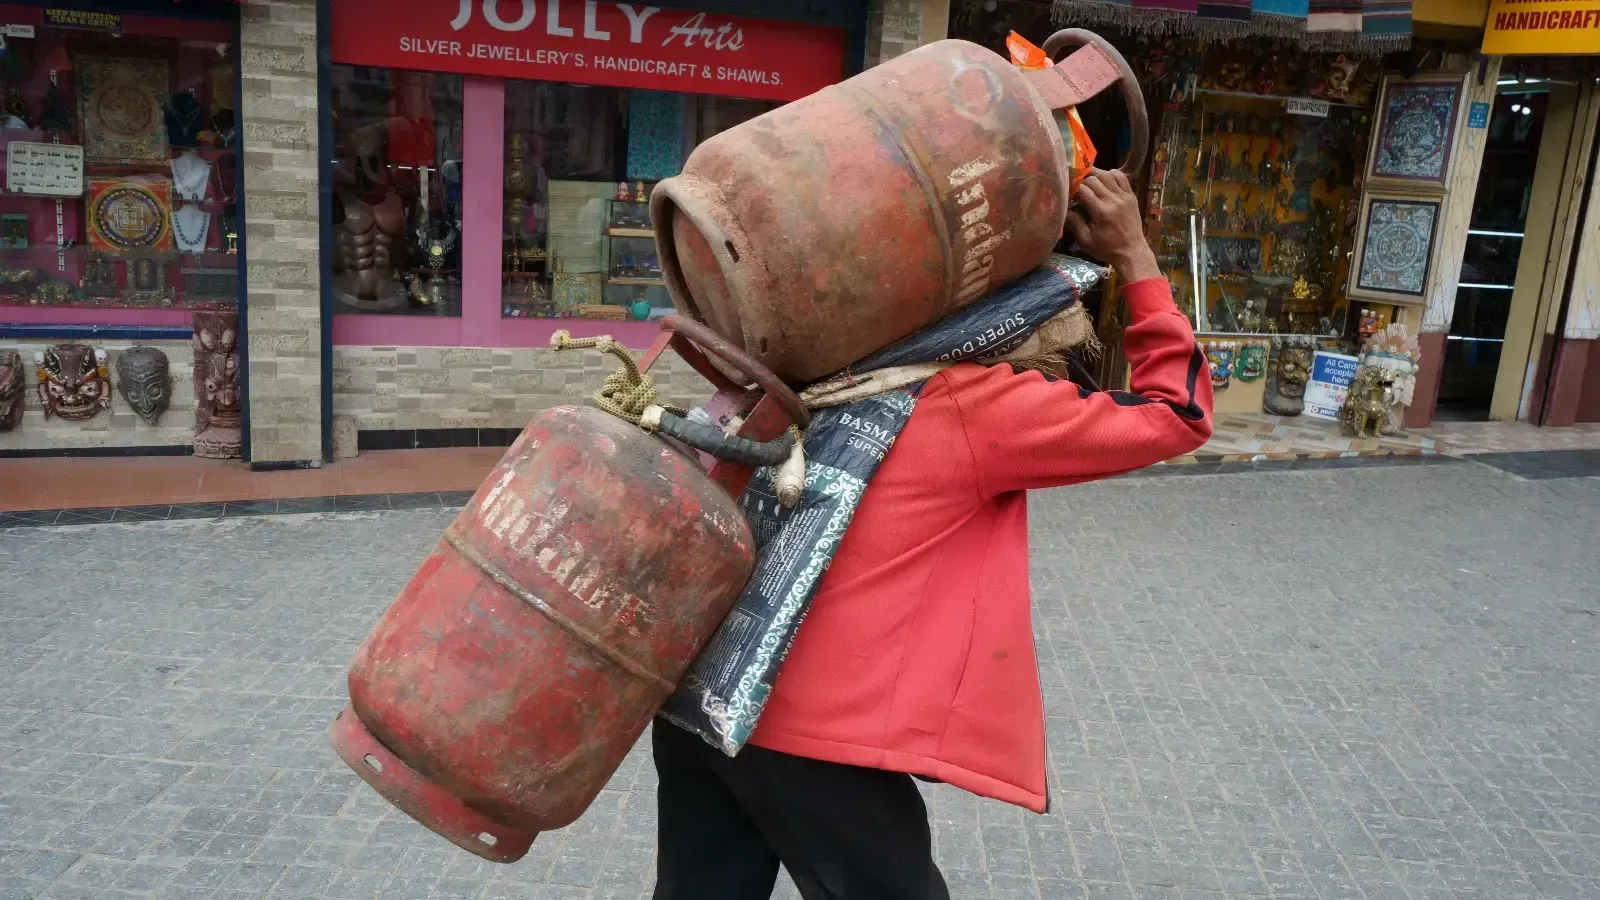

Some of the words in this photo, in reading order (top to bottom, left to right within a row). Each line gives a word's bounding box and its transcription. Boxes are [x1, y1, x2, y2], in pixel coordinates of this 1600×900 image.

[45, 8, 68, 16] KEEP
[50, 15, 77, 24] CLEAN
[87, 18, 116, 27] GREEN
[1493, 9, 1600, 31] HANDICRAFT
[449, 0, 661, 44] JOLLY
[661, 11, 745, 52] Arts
[399, 36, 462, 56] SILVER
[466, 43, 589, 68] JEWELLERY'S,
[593, 55, 698, 78] HANDICRAFT
[701, 65, 712, 79] &
[716, 66, 784, 86] SHAWLS.
[975, 312, 1025, 346] SUPER
[1331, 376, 1349, 384] here
[846, 436, 885, 462] SUPER
